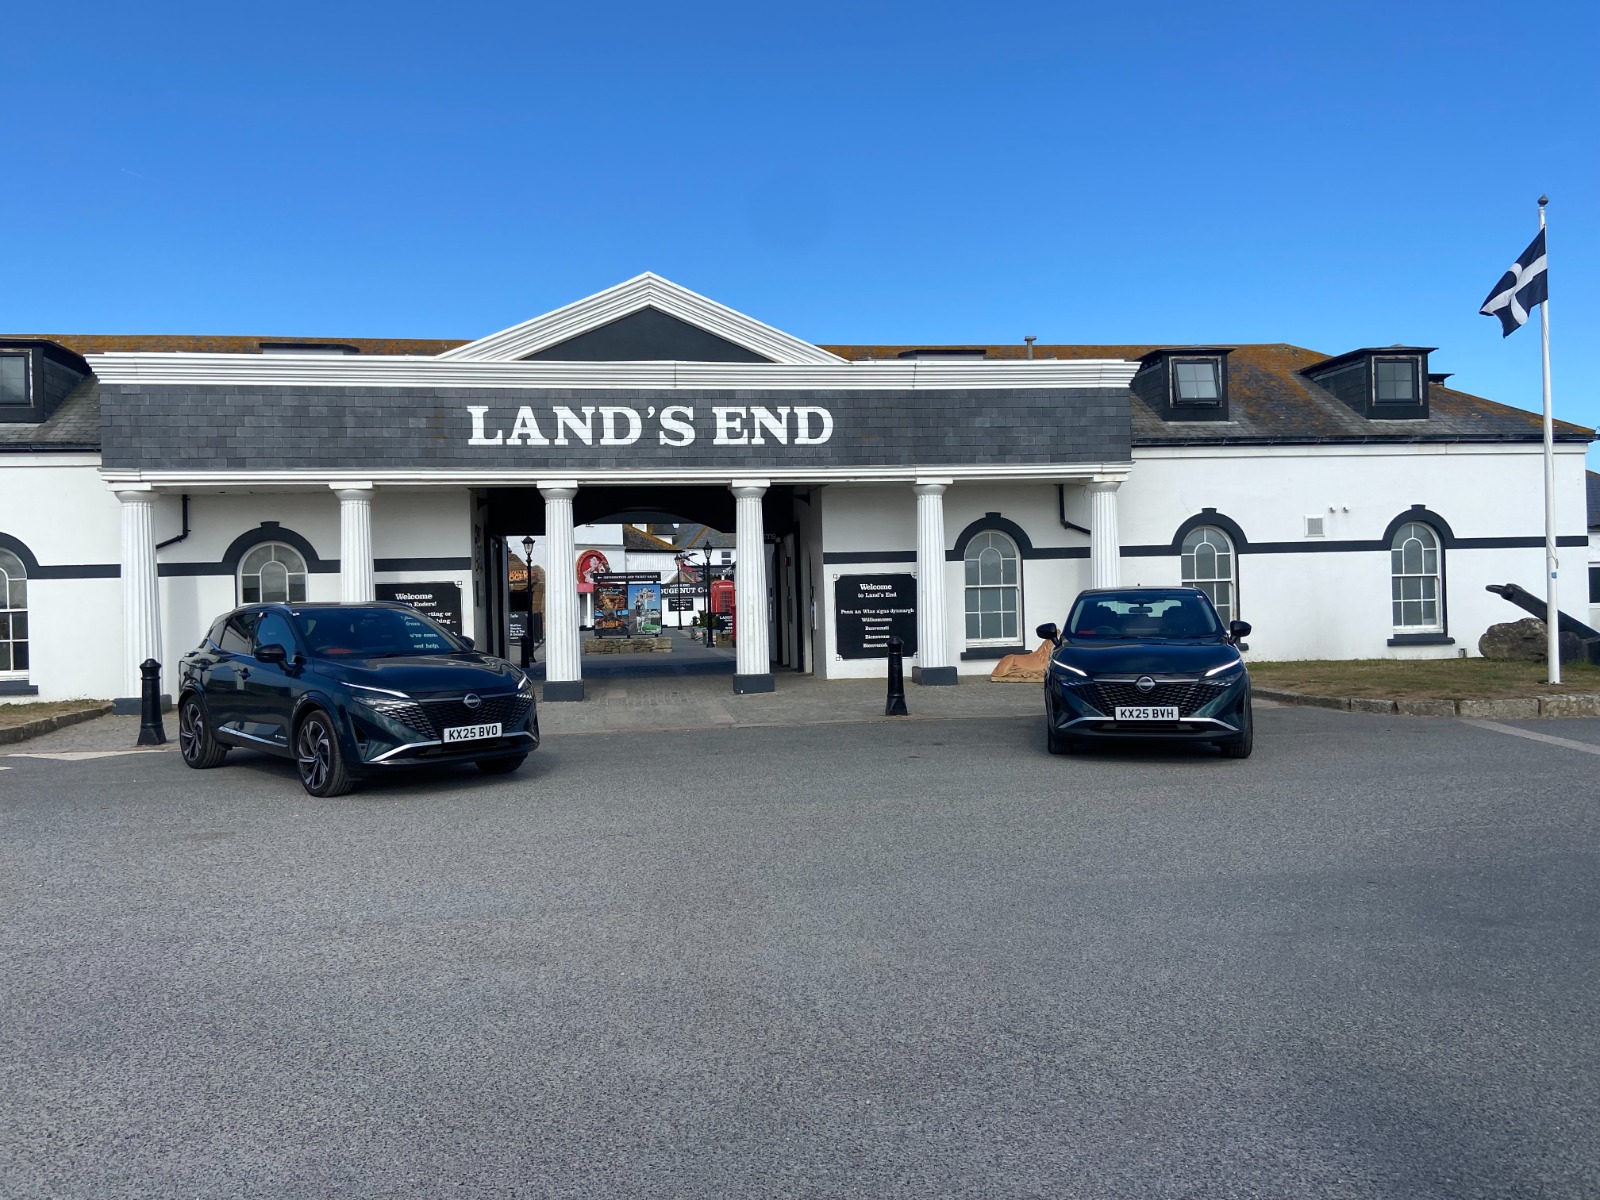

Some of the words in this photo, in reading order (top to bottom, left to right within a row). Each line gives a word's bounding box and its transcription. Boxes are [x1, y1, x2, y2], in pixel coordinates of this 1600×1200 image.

[466, 405, 696, 447] LAND'S
[711, 405, 834, 446] END
[859, 583, 893, 591] Welcome
[1120, 709, 1149, 719] KX25
[1151, 709, 1174, 719] BVH
[448, 728, 476, 741] KX25
[478, 725, 498, 738] BVO
